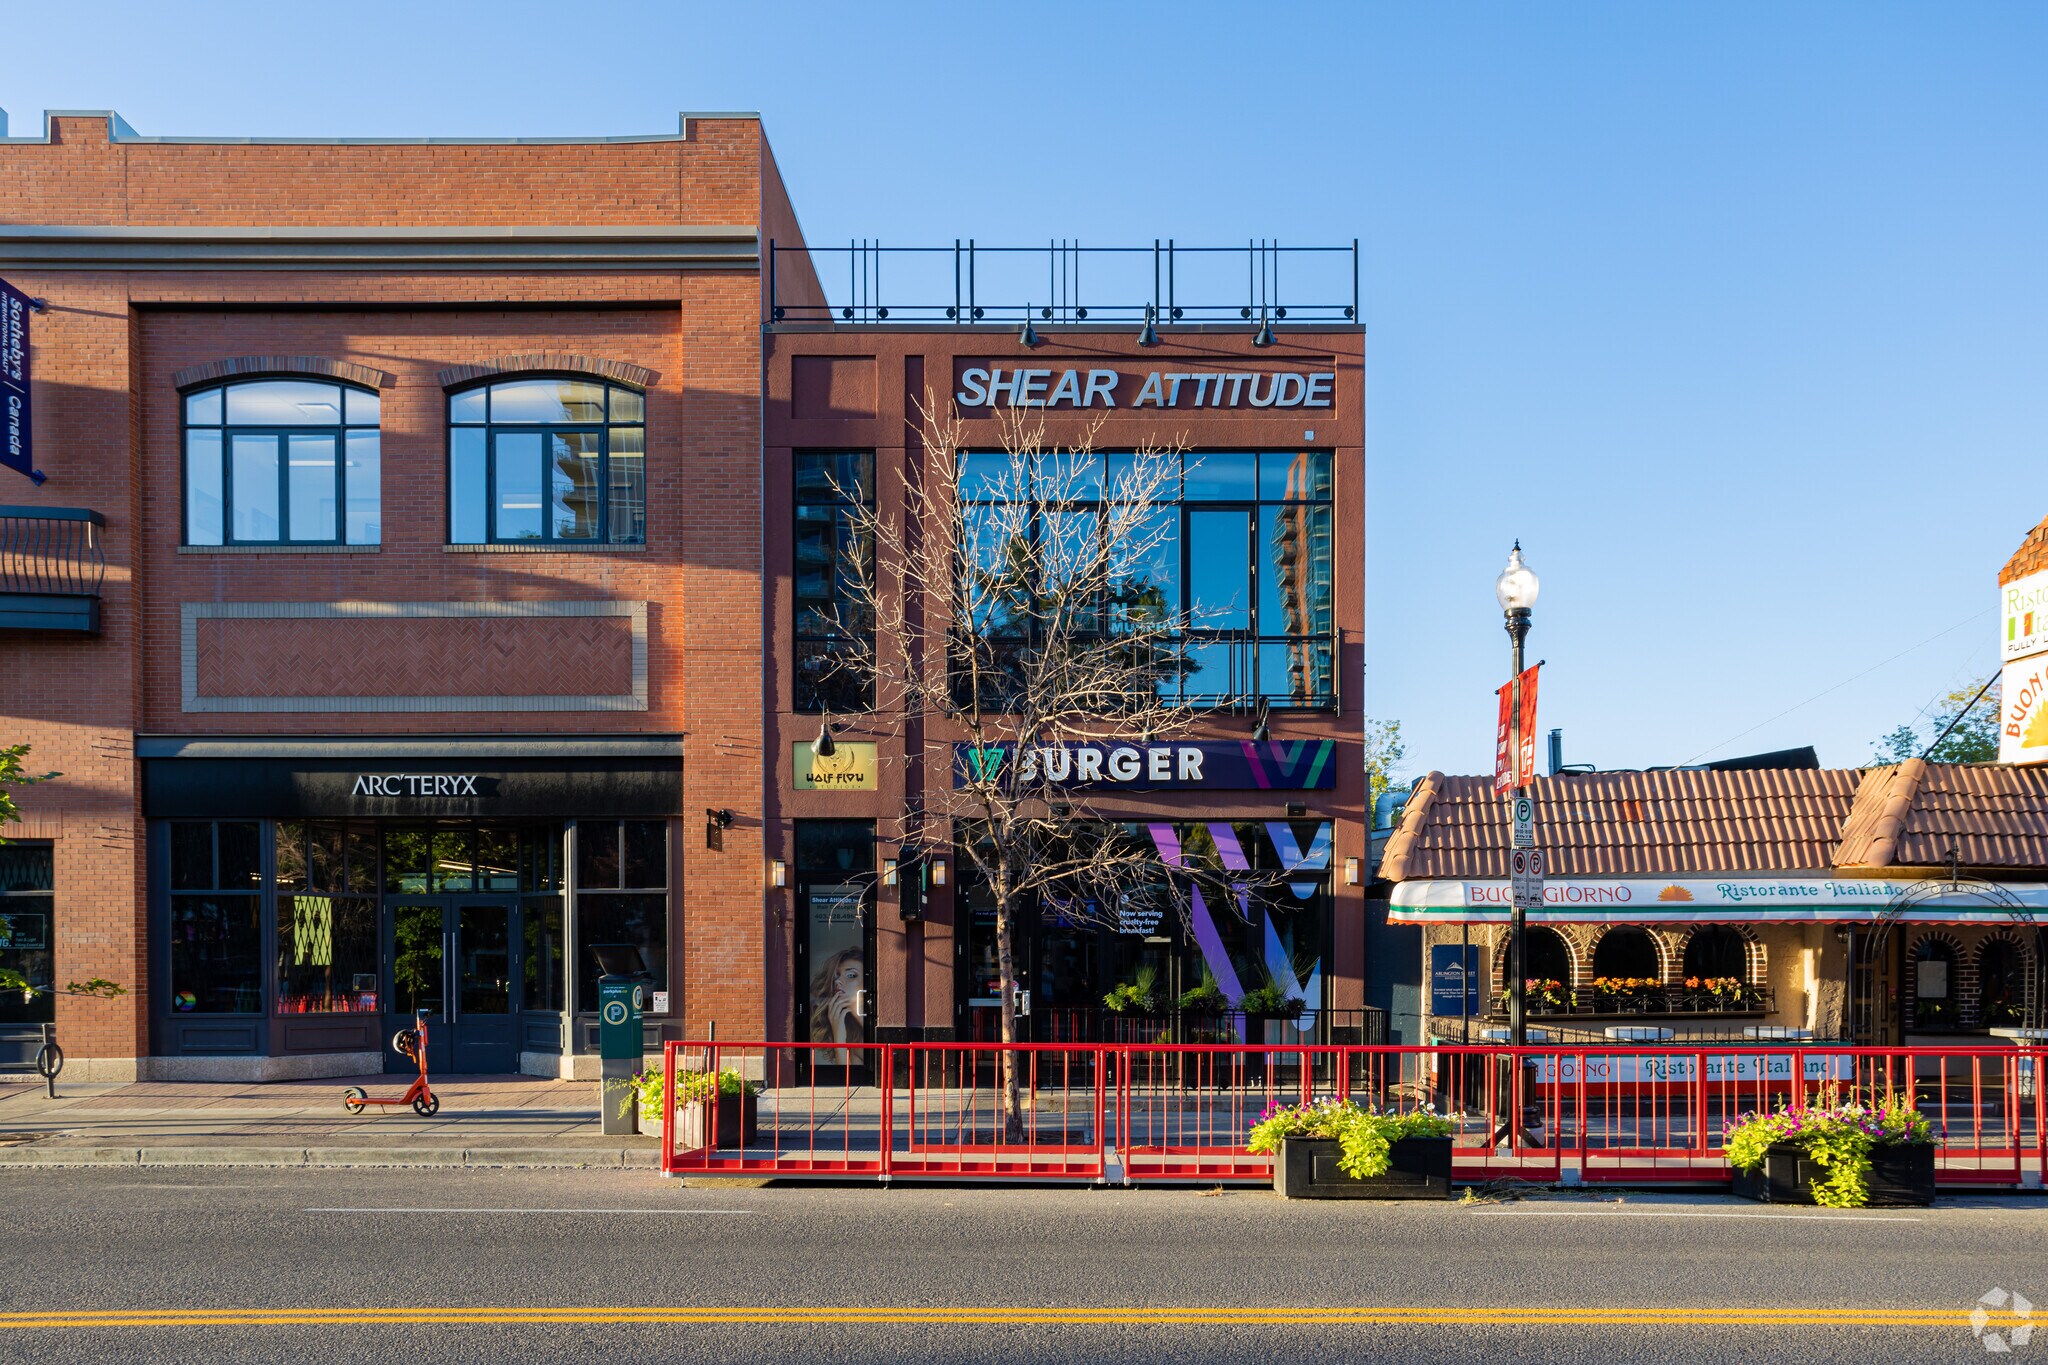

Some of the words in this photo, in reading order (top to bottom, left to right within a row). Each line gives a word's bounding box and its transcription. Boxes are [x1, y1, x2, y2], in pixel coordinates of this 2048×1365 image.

[9, 297, 24, 380] Sotheby's
[957, 368, 1118, 408] SHEAR
[1133, 372, 1334, 408] ATTITUDE
[9, 395, 21, 456] Canada
[2007, 637, 2037, 652] FULLY
[2006, 672, 2043, 738] BUON
[1013, 748, 1203, 782] BURGER
[352, 774, 477, 796] ARC'TERYX
[1471, 887, 1512, 902] BUO
[1543, 886, 1632, 903] GIORNO
[1717, 883, 1818, 901] Ristorante
[1824, 882, 1903, 898] Italiano
[1120, 918, 1159, 926] cruelty-free
[1138, 909, 1163, 918] serving
[1645, 1059, 1745, 1079] Ristoante
